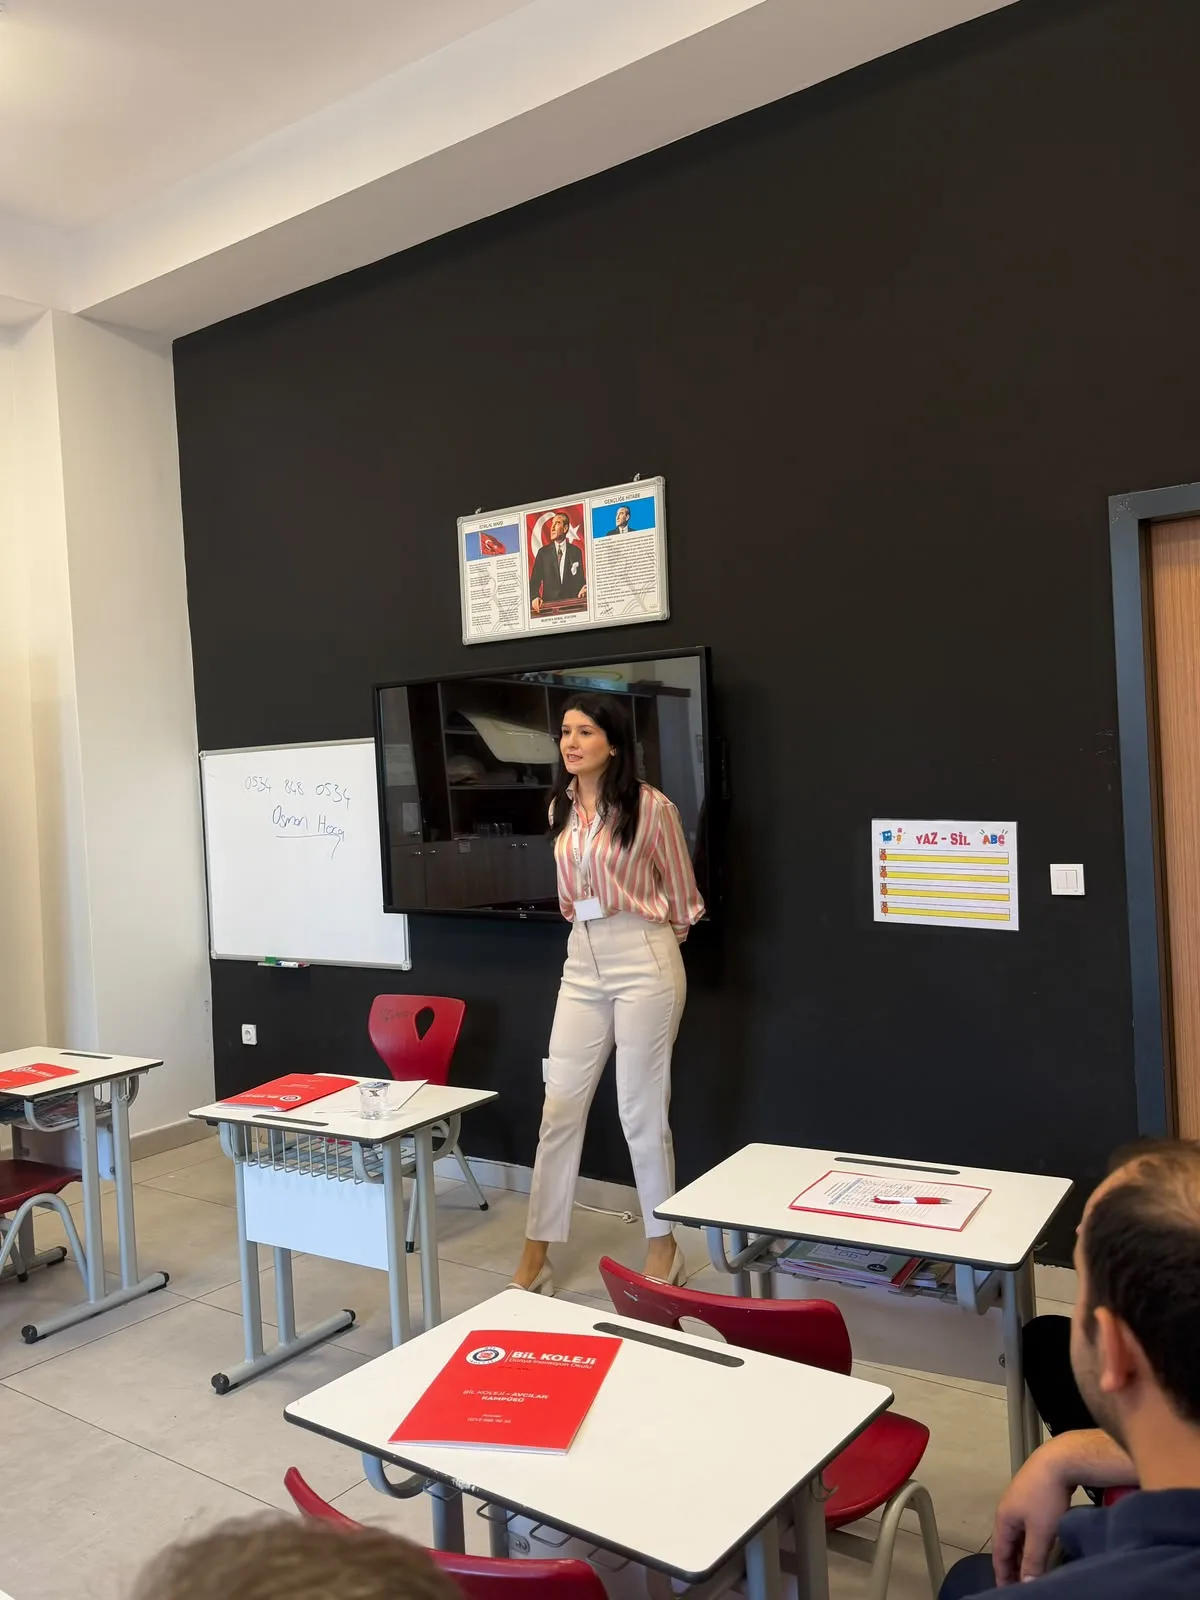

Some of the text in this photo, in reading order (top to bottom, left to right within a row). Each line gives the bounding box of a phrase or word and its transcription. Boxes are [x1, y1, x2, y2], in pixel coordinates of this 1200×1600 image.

[245, 776, 272, 795] 0534
[315, 782, 351, 809] 0534
[272, 805, 308, 830] Osman
[916, 832, 938, 845] YAZ
[950, 832, 971, 846] SİL
[982, 834, 1005, 846] ABC
[511, 1351, 597, 1365] BİL KOLEJİ
